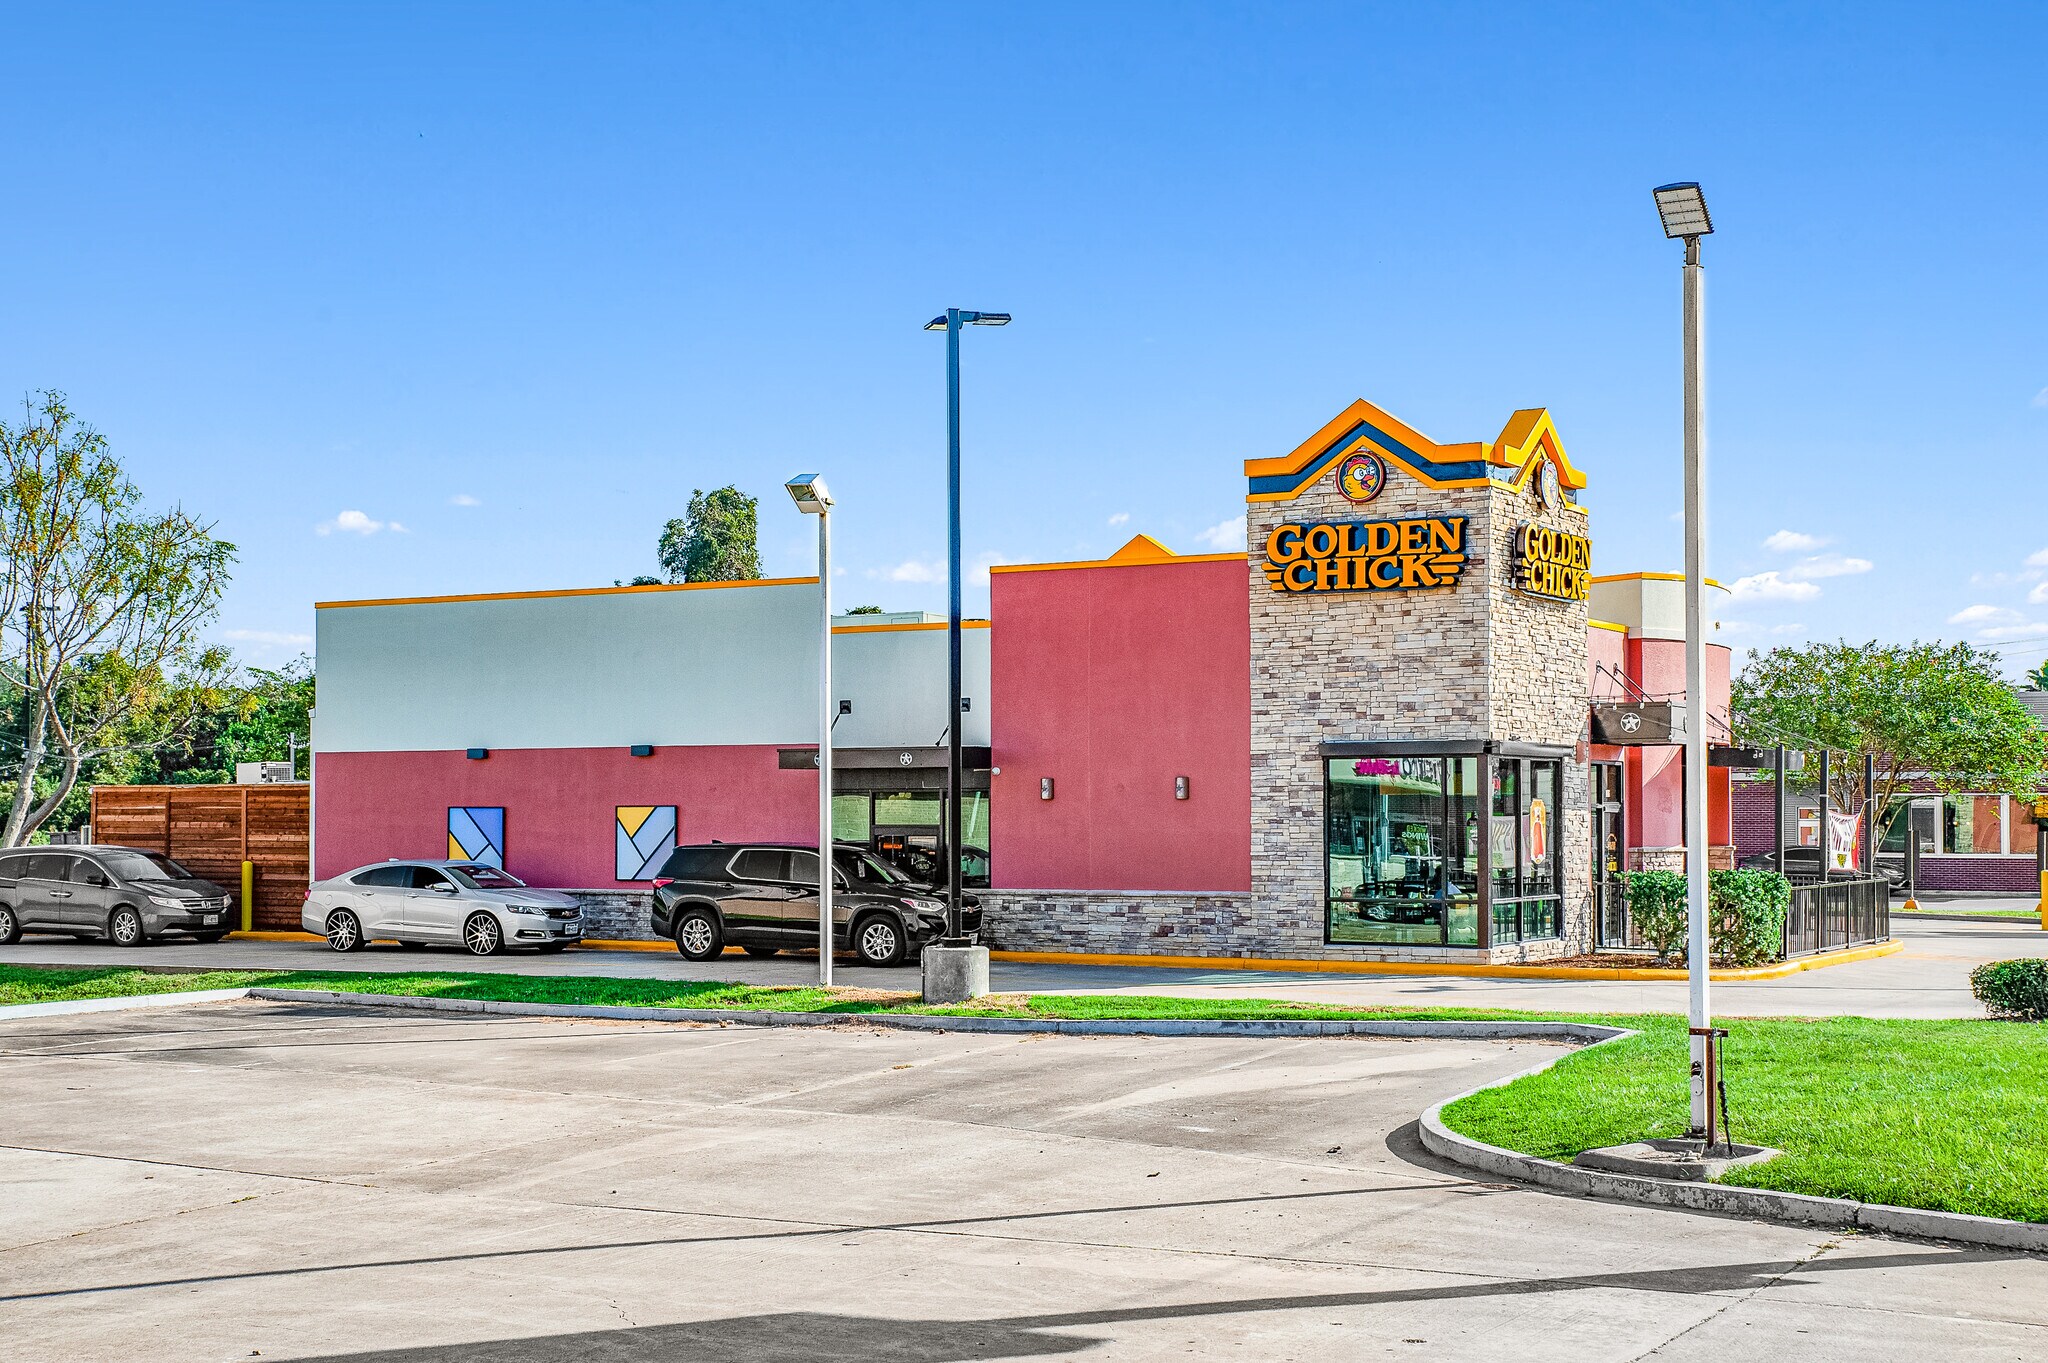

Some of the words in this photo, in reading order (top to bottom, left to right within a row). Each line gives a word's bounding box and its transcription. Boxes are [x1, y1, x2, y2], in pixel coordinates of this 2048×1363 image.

[1266, 517, 1464, 564] GOLDEN
[1525, 523, 1593, 570] GOLDEN
[1283, 553, 1440, 591] CHICK
[1531, 560, 1585, 600] CHICK
